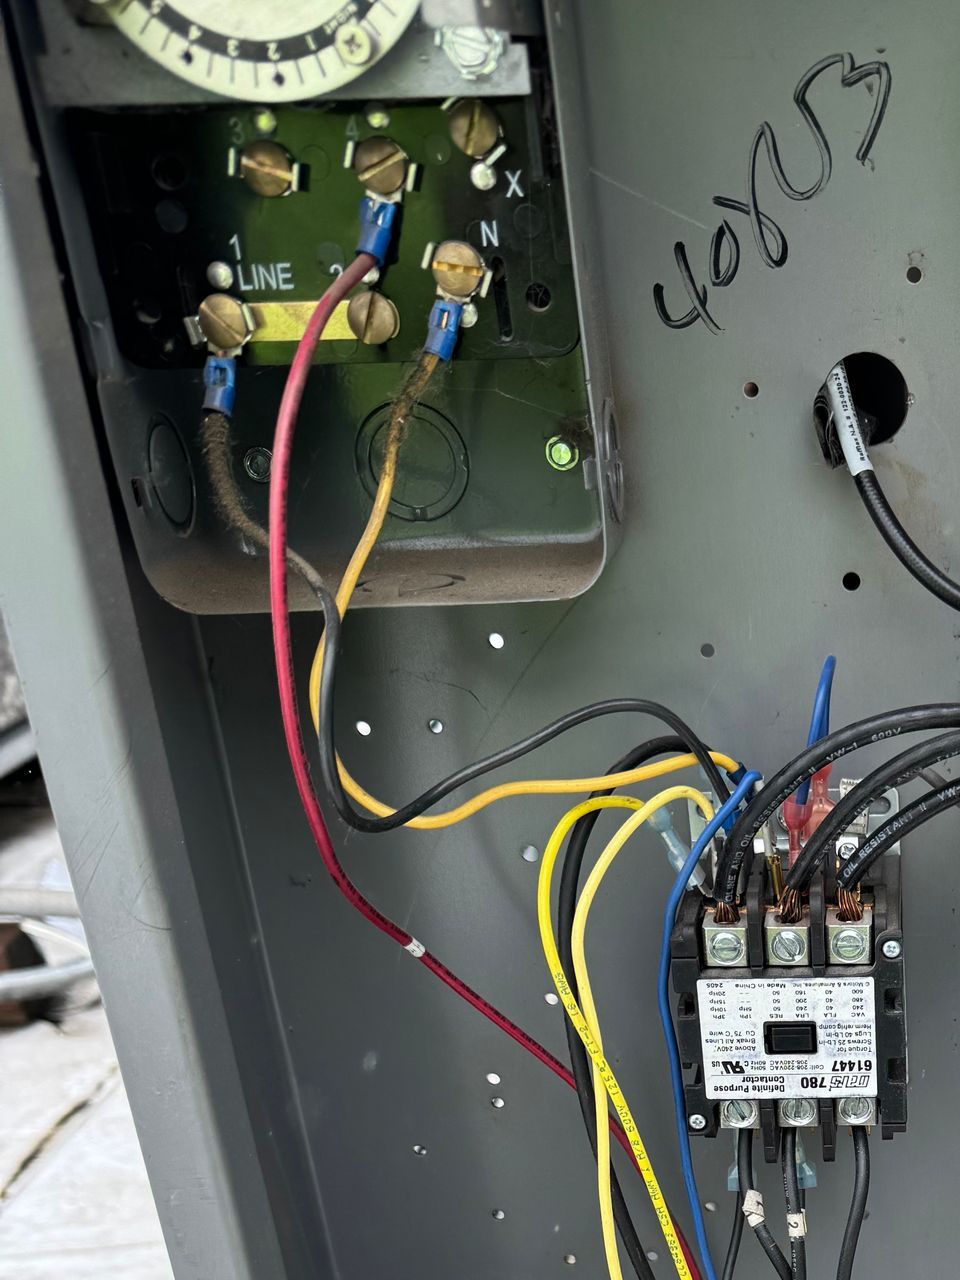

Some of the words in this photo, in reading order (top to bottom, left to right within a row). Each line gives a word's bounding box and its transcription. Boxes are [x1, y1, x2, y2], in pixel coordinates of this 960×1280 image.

[226, 39, 240, 57] 3
[266, 42, 281, 61] 2
[228, 117, 243, 144] 3
[346, 115, 359, 140] 4
[505, 170, 524, 198] X
[481, 220, 499, 247] N
[229, 234, 241, 260] 1
[237, 262, 295, 291] LINE
[753, 774, 804, 827] RESISTANT
[871, 727, 901, 742] 600V
[843, 861, 858, 878] OIL
[858, 812, 914, 859] RESISTANT
[848, 1045, 872, 1053] Torque
[831, 1060, 872, 1072] 61447
[713, 1082, 749, 1093] Purpose
[741, 1076, 785, 1084] Contactor
[752, 1084, 785, 1093] Definite
[800, 1077, 827, 1089] 780
[616, 1104, 635, 1133] 600V
